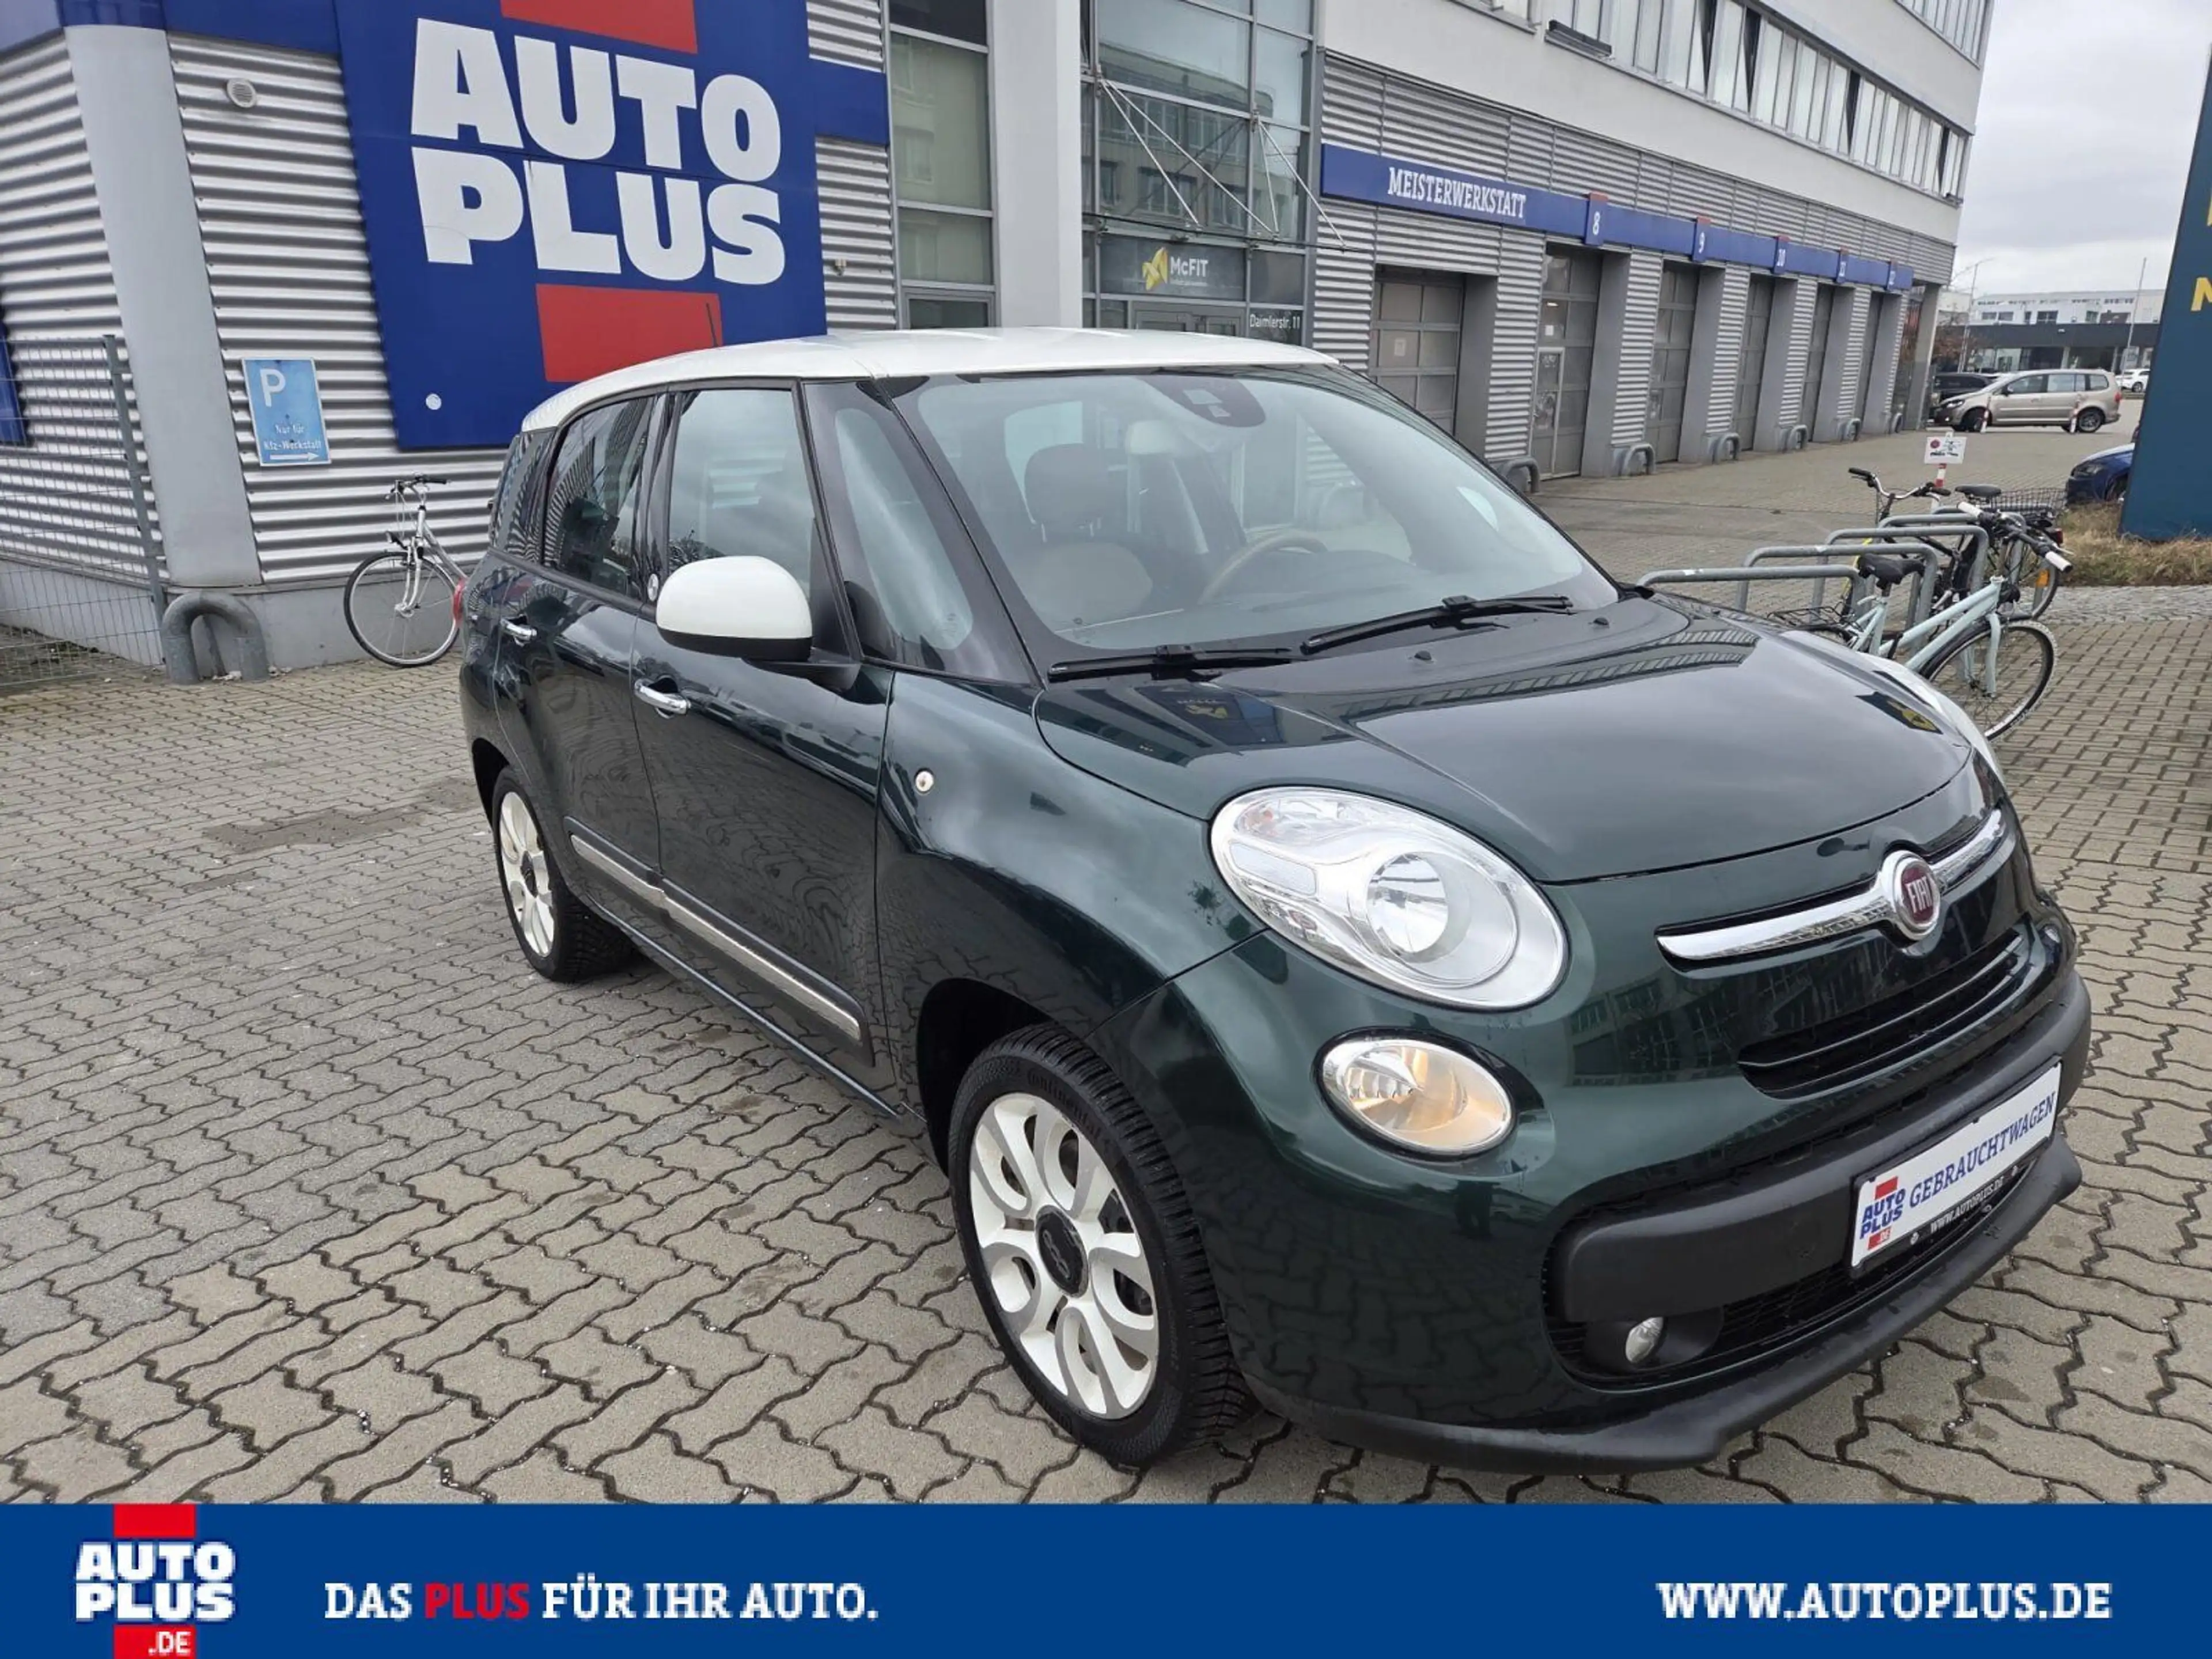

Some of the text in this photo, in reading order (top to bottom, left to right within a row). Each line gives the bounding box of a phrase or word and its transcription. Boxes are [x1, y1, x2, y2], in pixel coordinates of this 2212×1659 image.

[411, 18, 781, 182] AUTO
[1387, 167, 1527, 218] MEISTERWERKSTATT
[411, 146, 786, 285] PLUS
[1592, 211, 1601, 236] 8
[1698, 232, 1705, 253] 9
[1170, 256, 1209, 277] McFIT
[1249, 314, 1300, 329] Daimlerstr. 11
[260, 369, 286, 408] P
[1904, 876, 1934, 914] FIAT
[1910, 1090, 2056, 1209] GEBRAUCHTWAGEN
[1859, 1204, 1903, 1240] PLUS
[1862, 1188, 1906, 1224] AUTO
